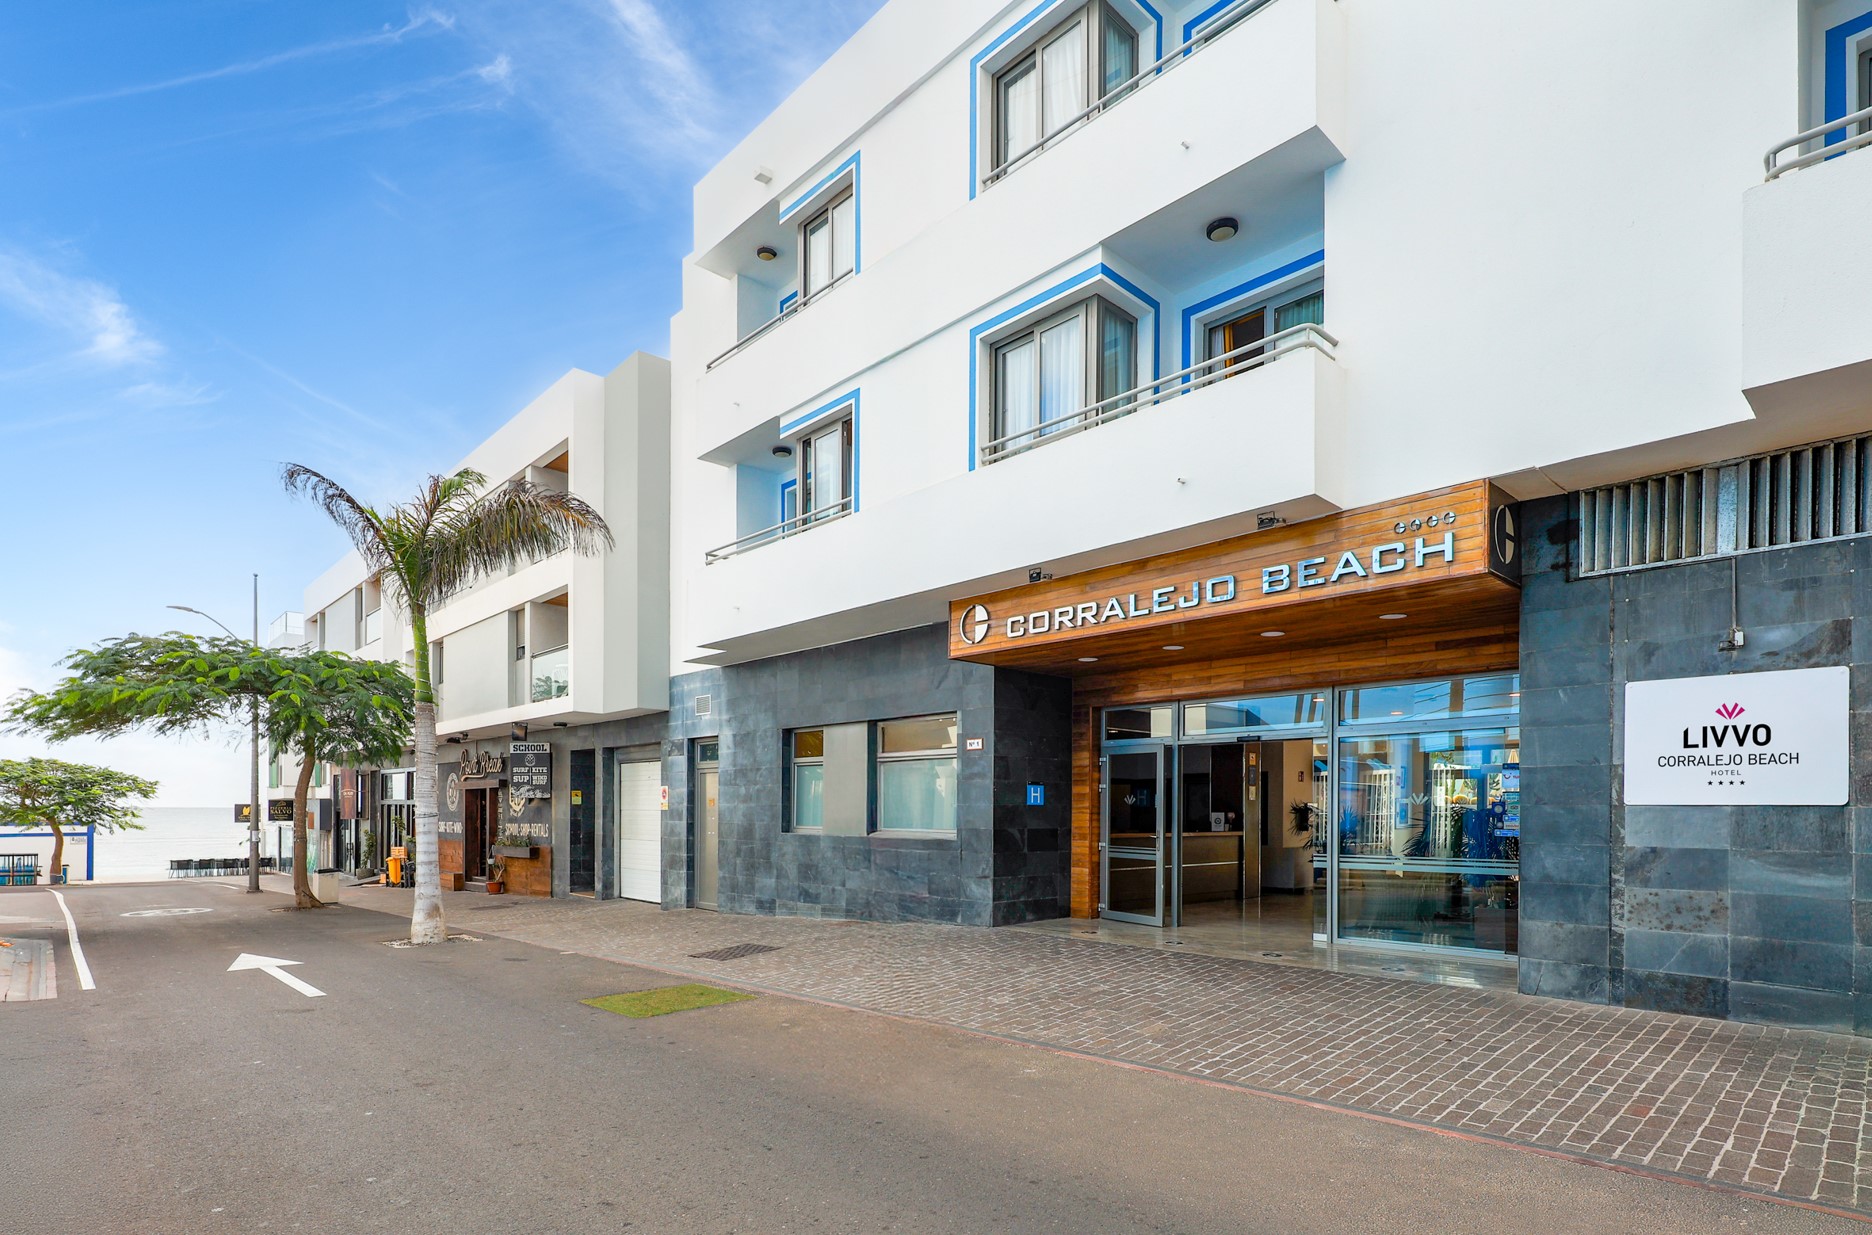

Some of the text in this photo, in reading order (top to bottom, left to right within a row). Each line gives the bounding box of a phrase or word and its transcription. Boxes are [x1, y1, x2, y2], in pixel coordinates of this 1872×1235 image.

[1006, 531, 1455, 639] CORRALEJO BEACH
[1683, 723, 1772, 749] LIVVO
[512, 744, 548, 752] SCHOOL
[1657, 752, 1800, 767] CORRALEJO BEACH
[513, 775, 529, 783] SUP
[1031, 787, 1041, 804] H
